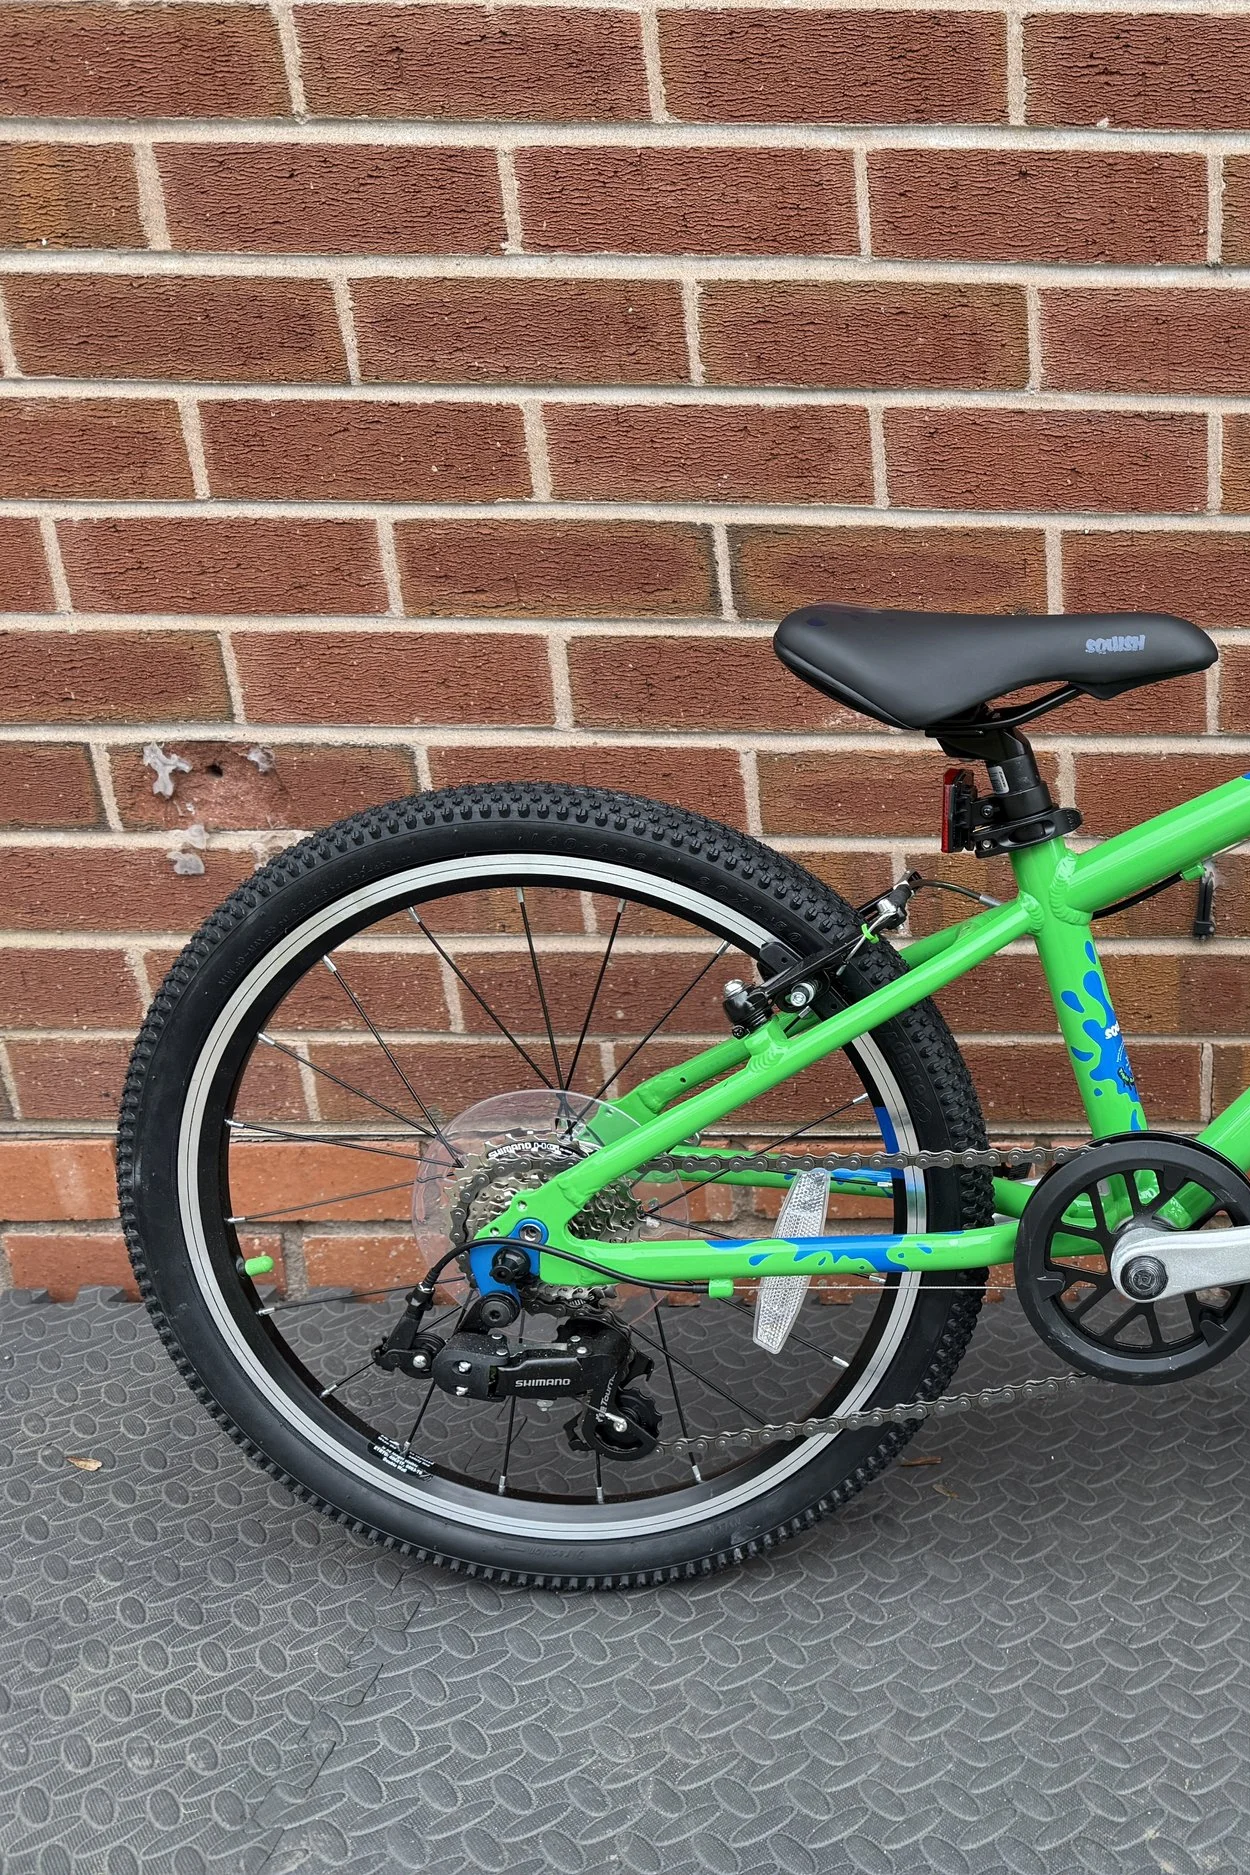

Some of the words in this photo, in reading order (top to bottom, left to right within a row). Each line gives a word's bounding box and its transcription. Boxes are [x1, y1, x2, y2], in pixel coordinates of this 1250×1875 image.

[1085, 635, 1146, 654] SQUISH
[488, 1141, 531, 1158] SHIMANO
[515, 1378, 571, 1388] SHIMANO
